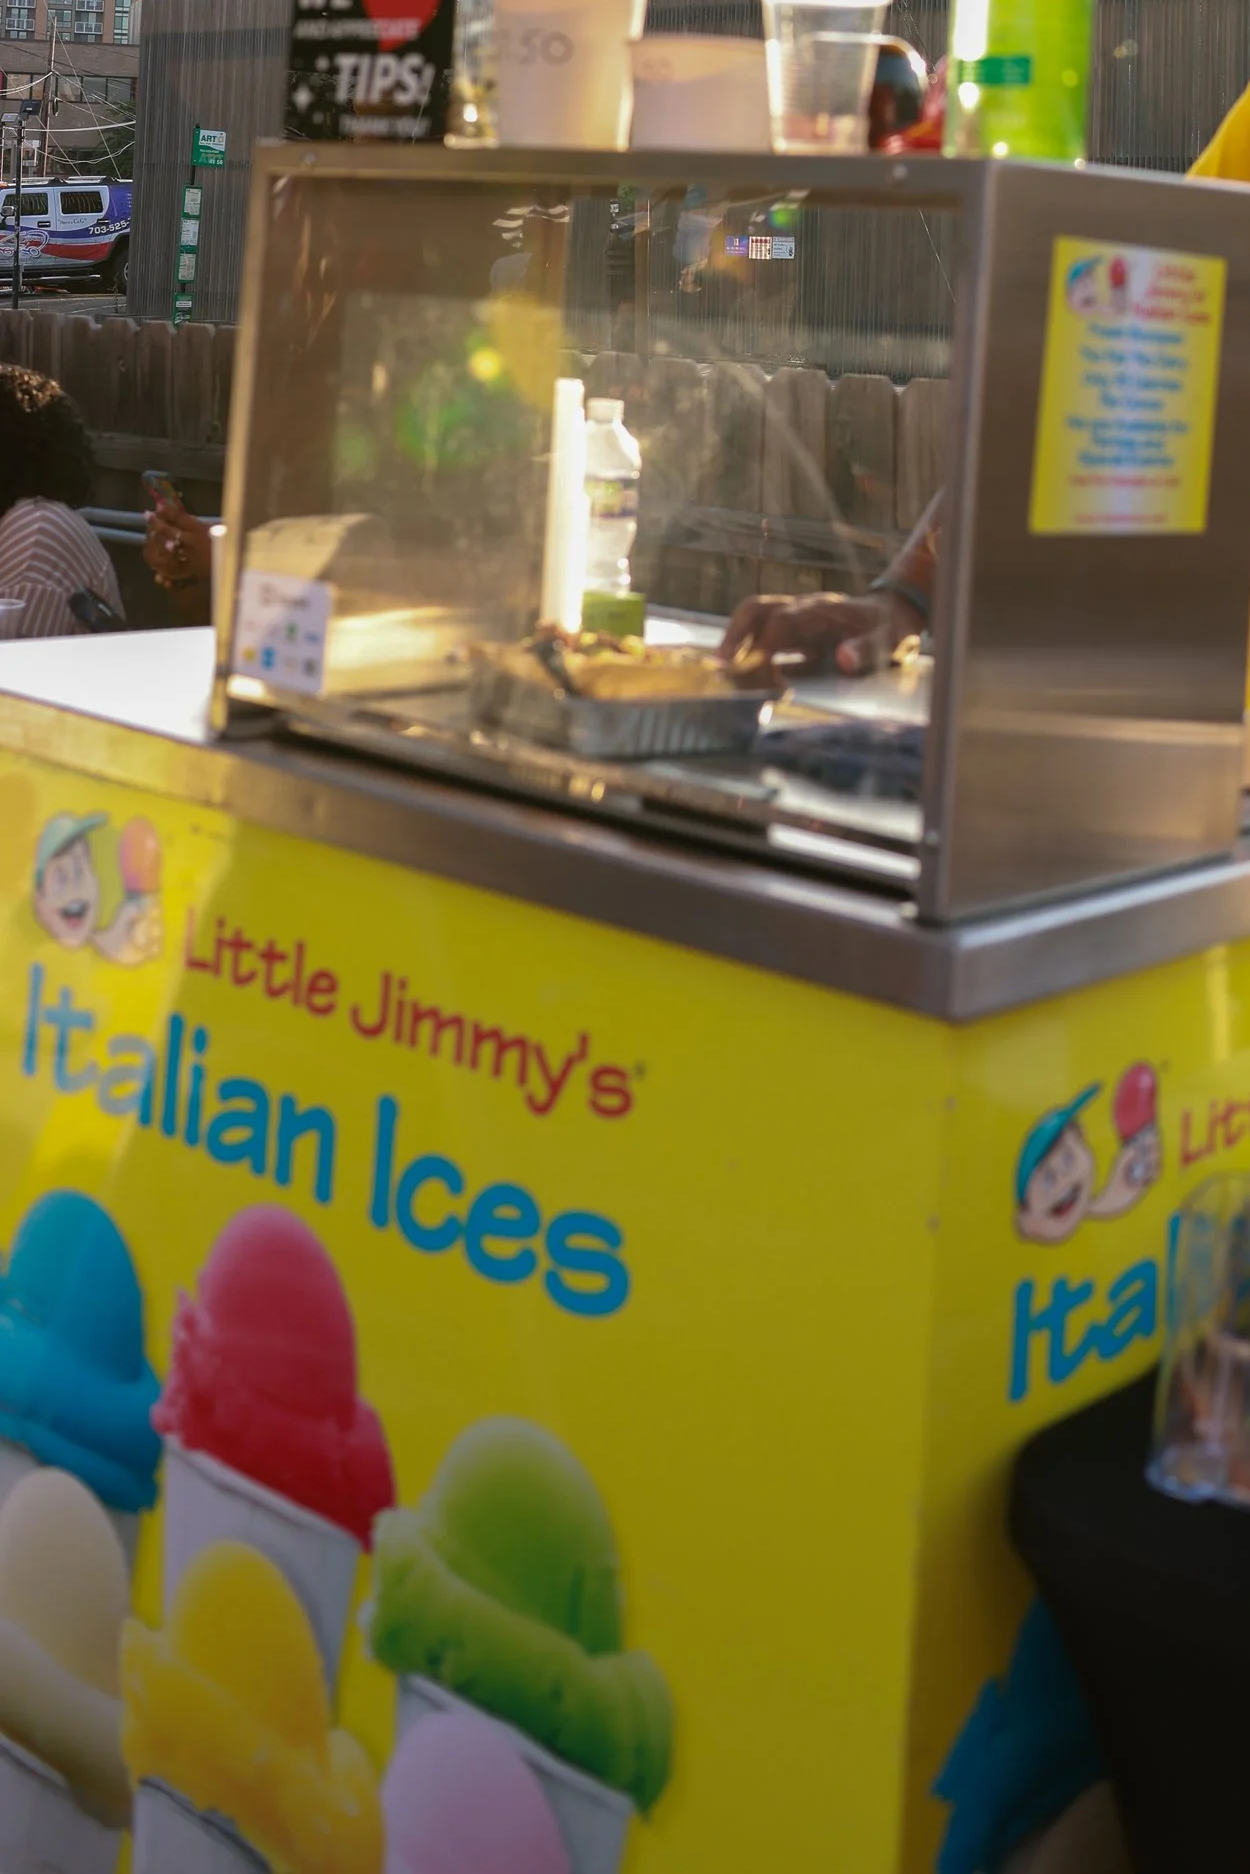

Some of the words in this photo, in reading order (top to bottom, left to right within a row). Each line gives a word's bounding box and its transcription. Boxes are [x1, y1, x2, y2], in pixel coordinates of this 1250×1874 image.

[333, 52, 437, 106] TIPS!
[88, 217, 131, 235] 703-525-
[184, 906, 338, 1018] Little
[350, 972, 635, 1118] Jimmy's
[21, 962, 337, 1206] Italian
[368, 1094, 631, 1320] Ices
